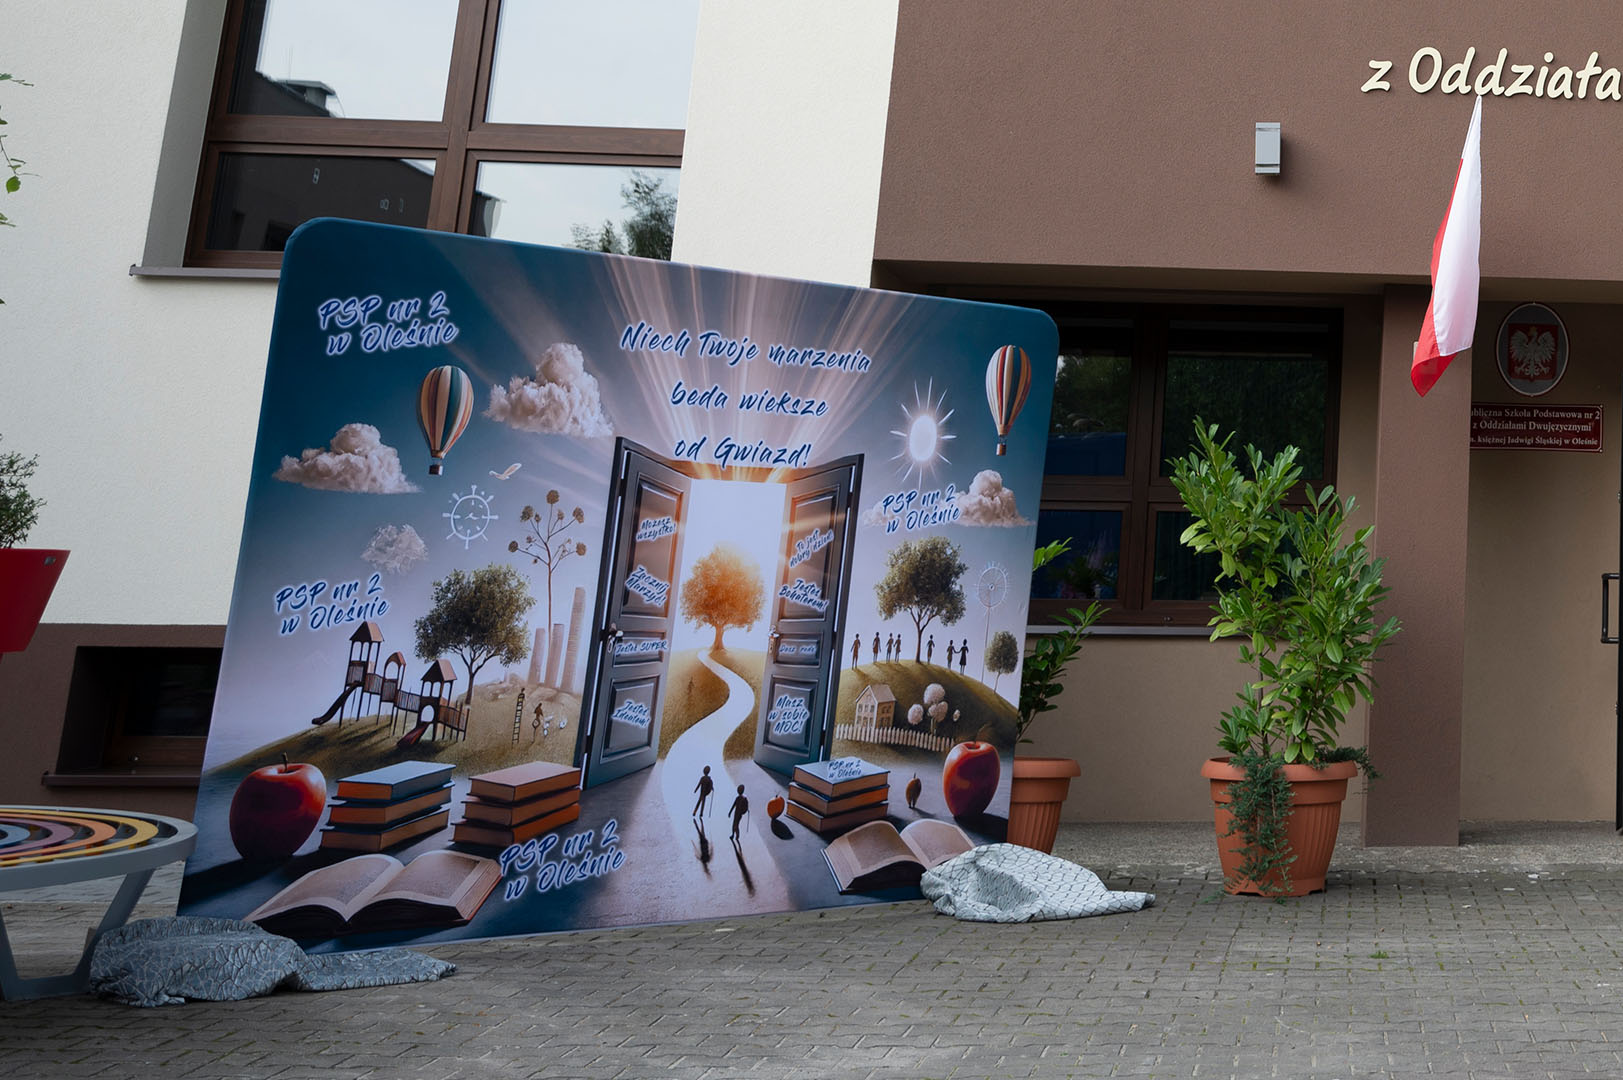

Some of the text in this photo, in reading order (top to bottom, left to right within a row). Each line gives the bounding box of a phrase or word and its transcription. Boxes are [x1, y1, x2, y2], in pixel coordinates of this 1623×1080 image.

[1360, 59, 1393, 93] z
[319, 291, 449, 329] PSP nr 2
[327, 318, 458, 355] w Oleśnie
[620, 321, 872, 372] Niech Twoje marzenia
[671, 381, 829, 416] beda wieksze
[1533, 409, 1582, 419] Podstawowa
[1595, 410, 1600, 420] 2
[1528, 422, 1592, 433] Dwujęzycznymi
[674, 436, 812, 469] od Gwiazd!
[882, 485, 956, 515] PSP nr 2
[886, 504, 960, 533] w Oleśnie
[276, 574, 383, 613] PSP nr 2
[631, 567, 670, 595] Zacznij
[281, 596, 389, 634] w Oleśnie
[769, 708, 808, 720] w sobie
[776, 696, 804, 709] Masz
[774, 720, 802, 733] MOC!
[501, 819, 618, 876] PSP nr 2
[506, 847, 625, 899] w Oleśnie
